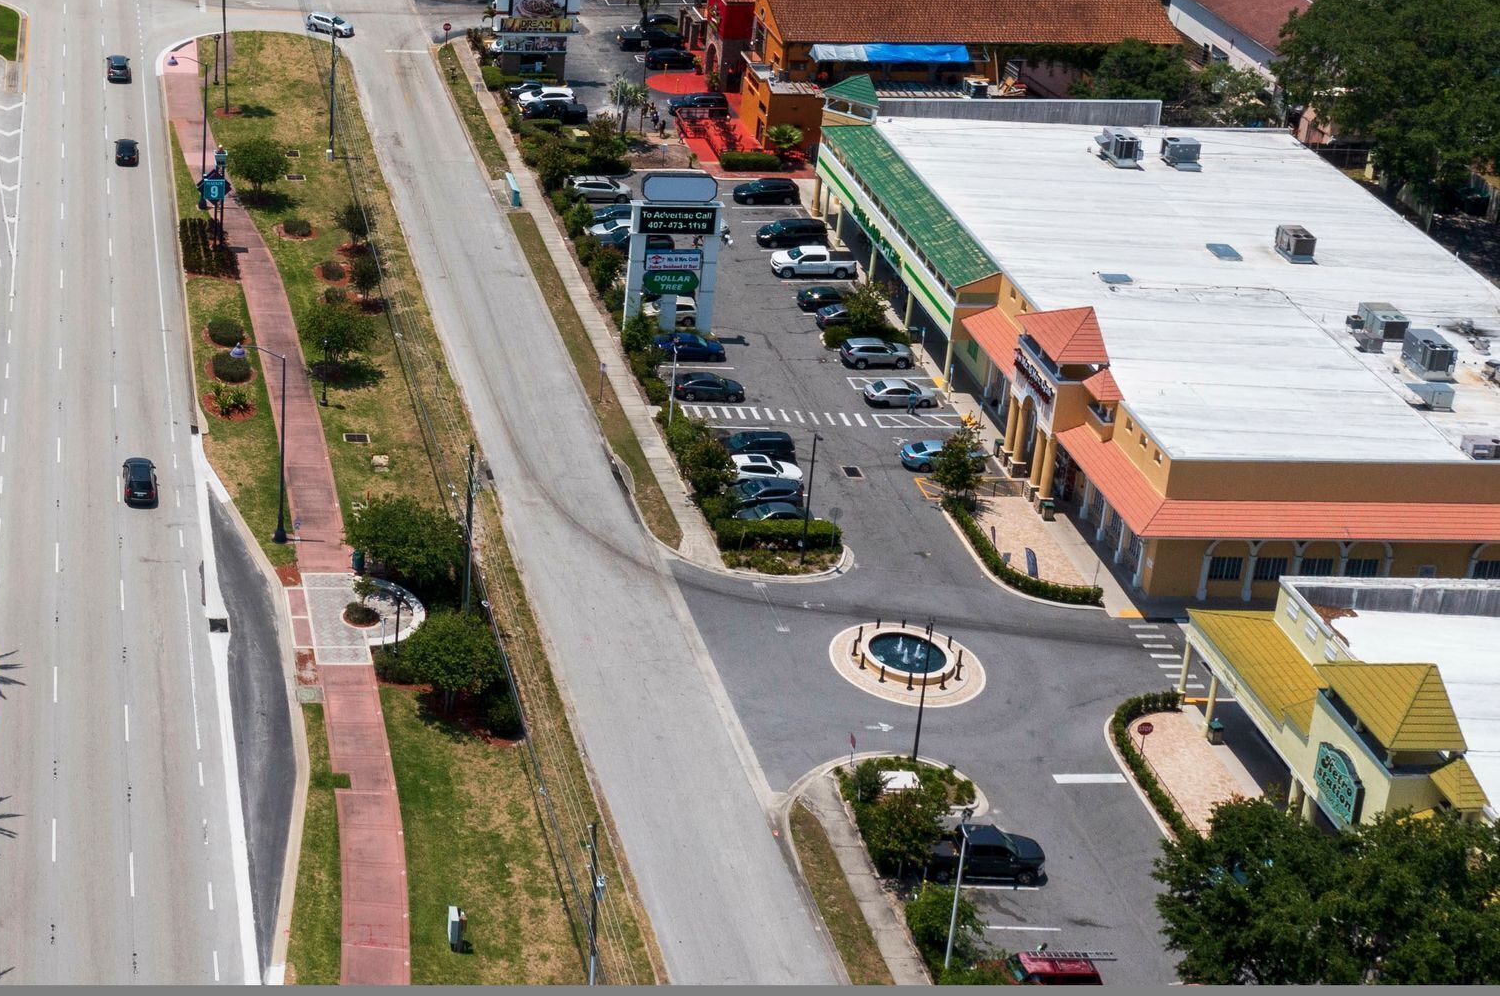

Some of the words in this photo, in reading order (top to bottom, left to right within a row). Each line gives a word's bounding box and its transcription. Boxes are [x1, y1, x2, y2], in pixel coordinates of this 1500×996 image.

[521, 19, 553, 28] DREAM
[210, 185, 219, 198] 9
[642, 211, 652, 219] To
[653, 211, 694, 219] Advertise
[695, 212, 713, 220] Call
[653, 275, 691, 283] DOLLAR
[660, 283, 683, 291] TREE
